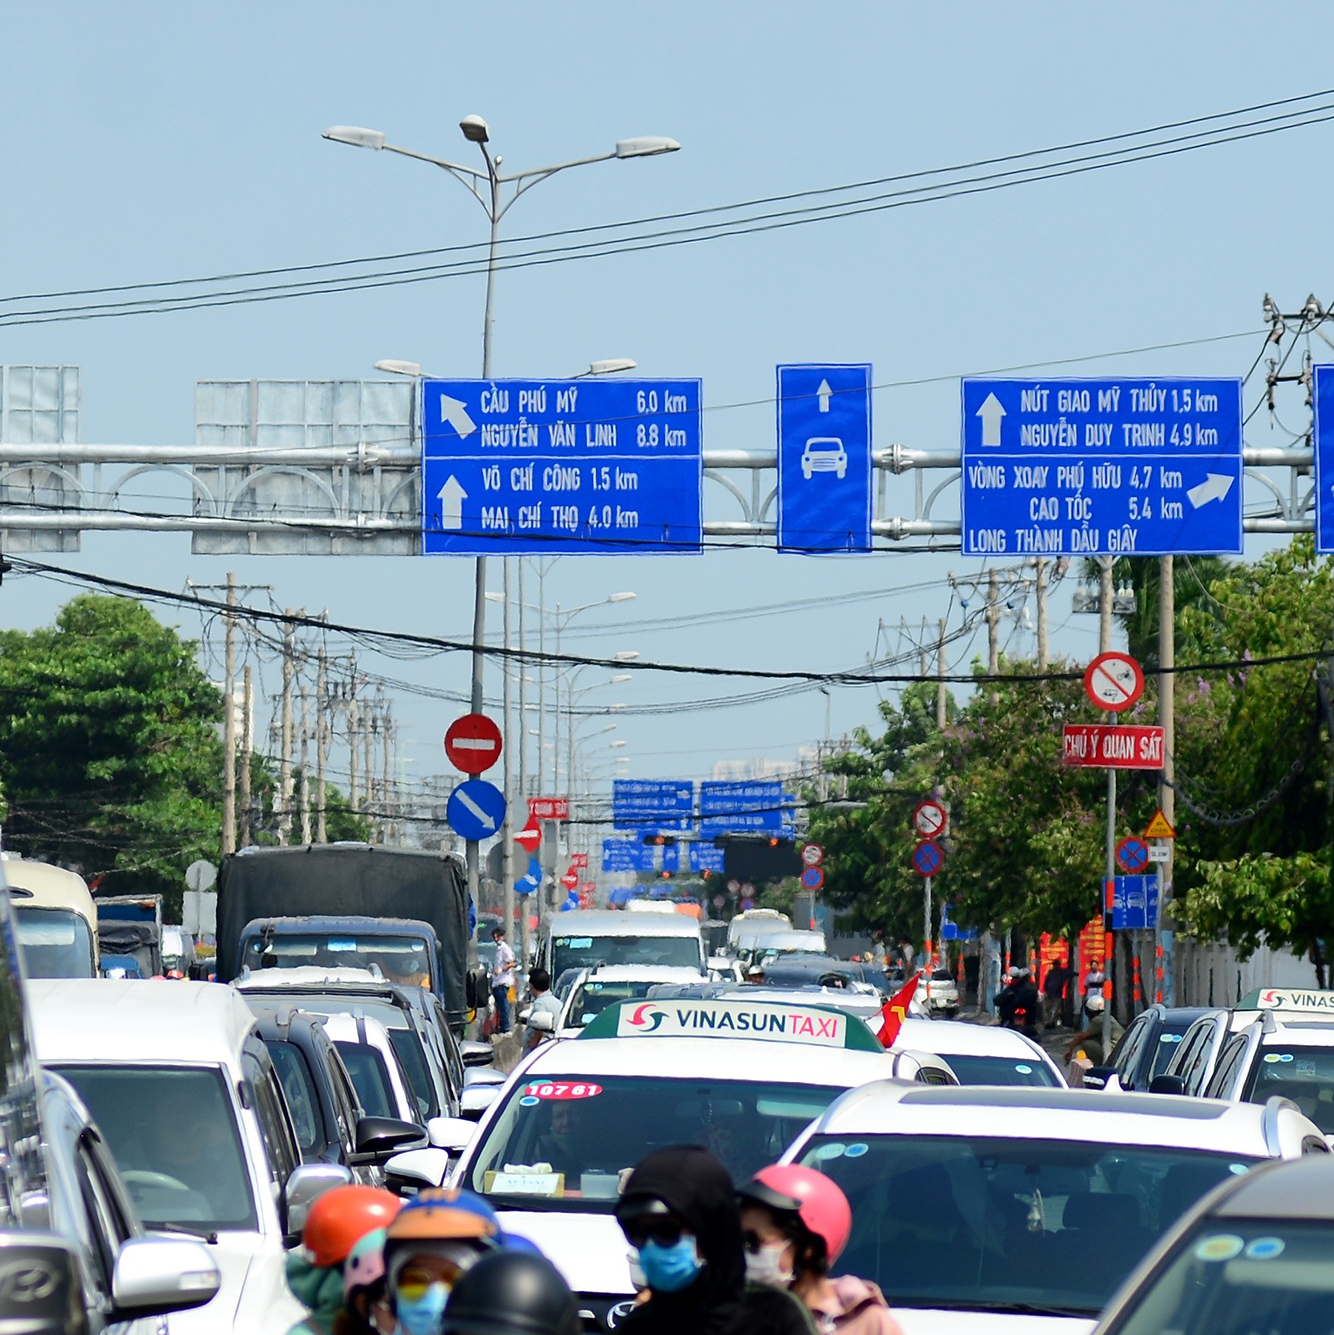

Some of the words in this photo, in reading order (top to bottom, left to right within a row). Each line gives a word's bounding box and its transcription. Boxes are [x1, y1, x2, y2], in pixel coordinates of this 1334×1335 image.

[481, 382, 509, 414] CẦU
[519, 385, 547, 413] PHÚ
[557, 386, 578, 413] MỸ
[664, 390, 687, 413] km
[1021, 385, 1049, 412] NÚT
[1058, 390, 1091, 412] GIAO
[1098, 386, 1121, 412] MỸ
[1130, 383, 1167, 412] THỦY
[1195, 389, 1218, 412] km
[481, 417, 539, 448] NGUYỄN
[549, 421, 576, 448] VĂN
[585, 424, 617, 448] LINH
[665, 424, 687, 447] km
[1020, 416, 1077, 446] NGUYỄN
[1085, 424, 1113, 446] DUY
[1122, 423, 1165, 446] TRINH
[1195, 423, 1218, 446] km
[482, 464, 501, 491] VÕ
[510, 462, 535, 491] CHÍ
[543, 464, 581, 491] CÔNG
[615, 466, 638, 490] km
[969, 461, 1006, 489] VÒNG
[1013, 466, 1049, 488] XOAY
[1057, 460, 1085, 488] PHÚ
[1092, 462, 1121, 489] HỮU
[1160, 466, 1183, 488] km
[481, 506, 509, 529] MAI
[518, 502, 541, 529] CHÍ
[551, 506, 579, 532] THỌ
[616, 505, 639, 528] km
[1029, 497, 1059, 520] CAO
[1065, 490, 1093, 520] TỐC
[1161, 496, 1183, 520] km
[969, 530, 1007, 552] LONG
[1015, 524, 1063, 552] THÀNH
[1071, 520, 1100, 552] DẦU
[1107, 524, 1138, 552] GIÂY
[1064, 728, 1087, 758] CHÚ
[1090, 729, 1099, 758] Ý
[1103, 734, 1135, 760] QUAN
[1139, 730, 1163, 760] SÁT
